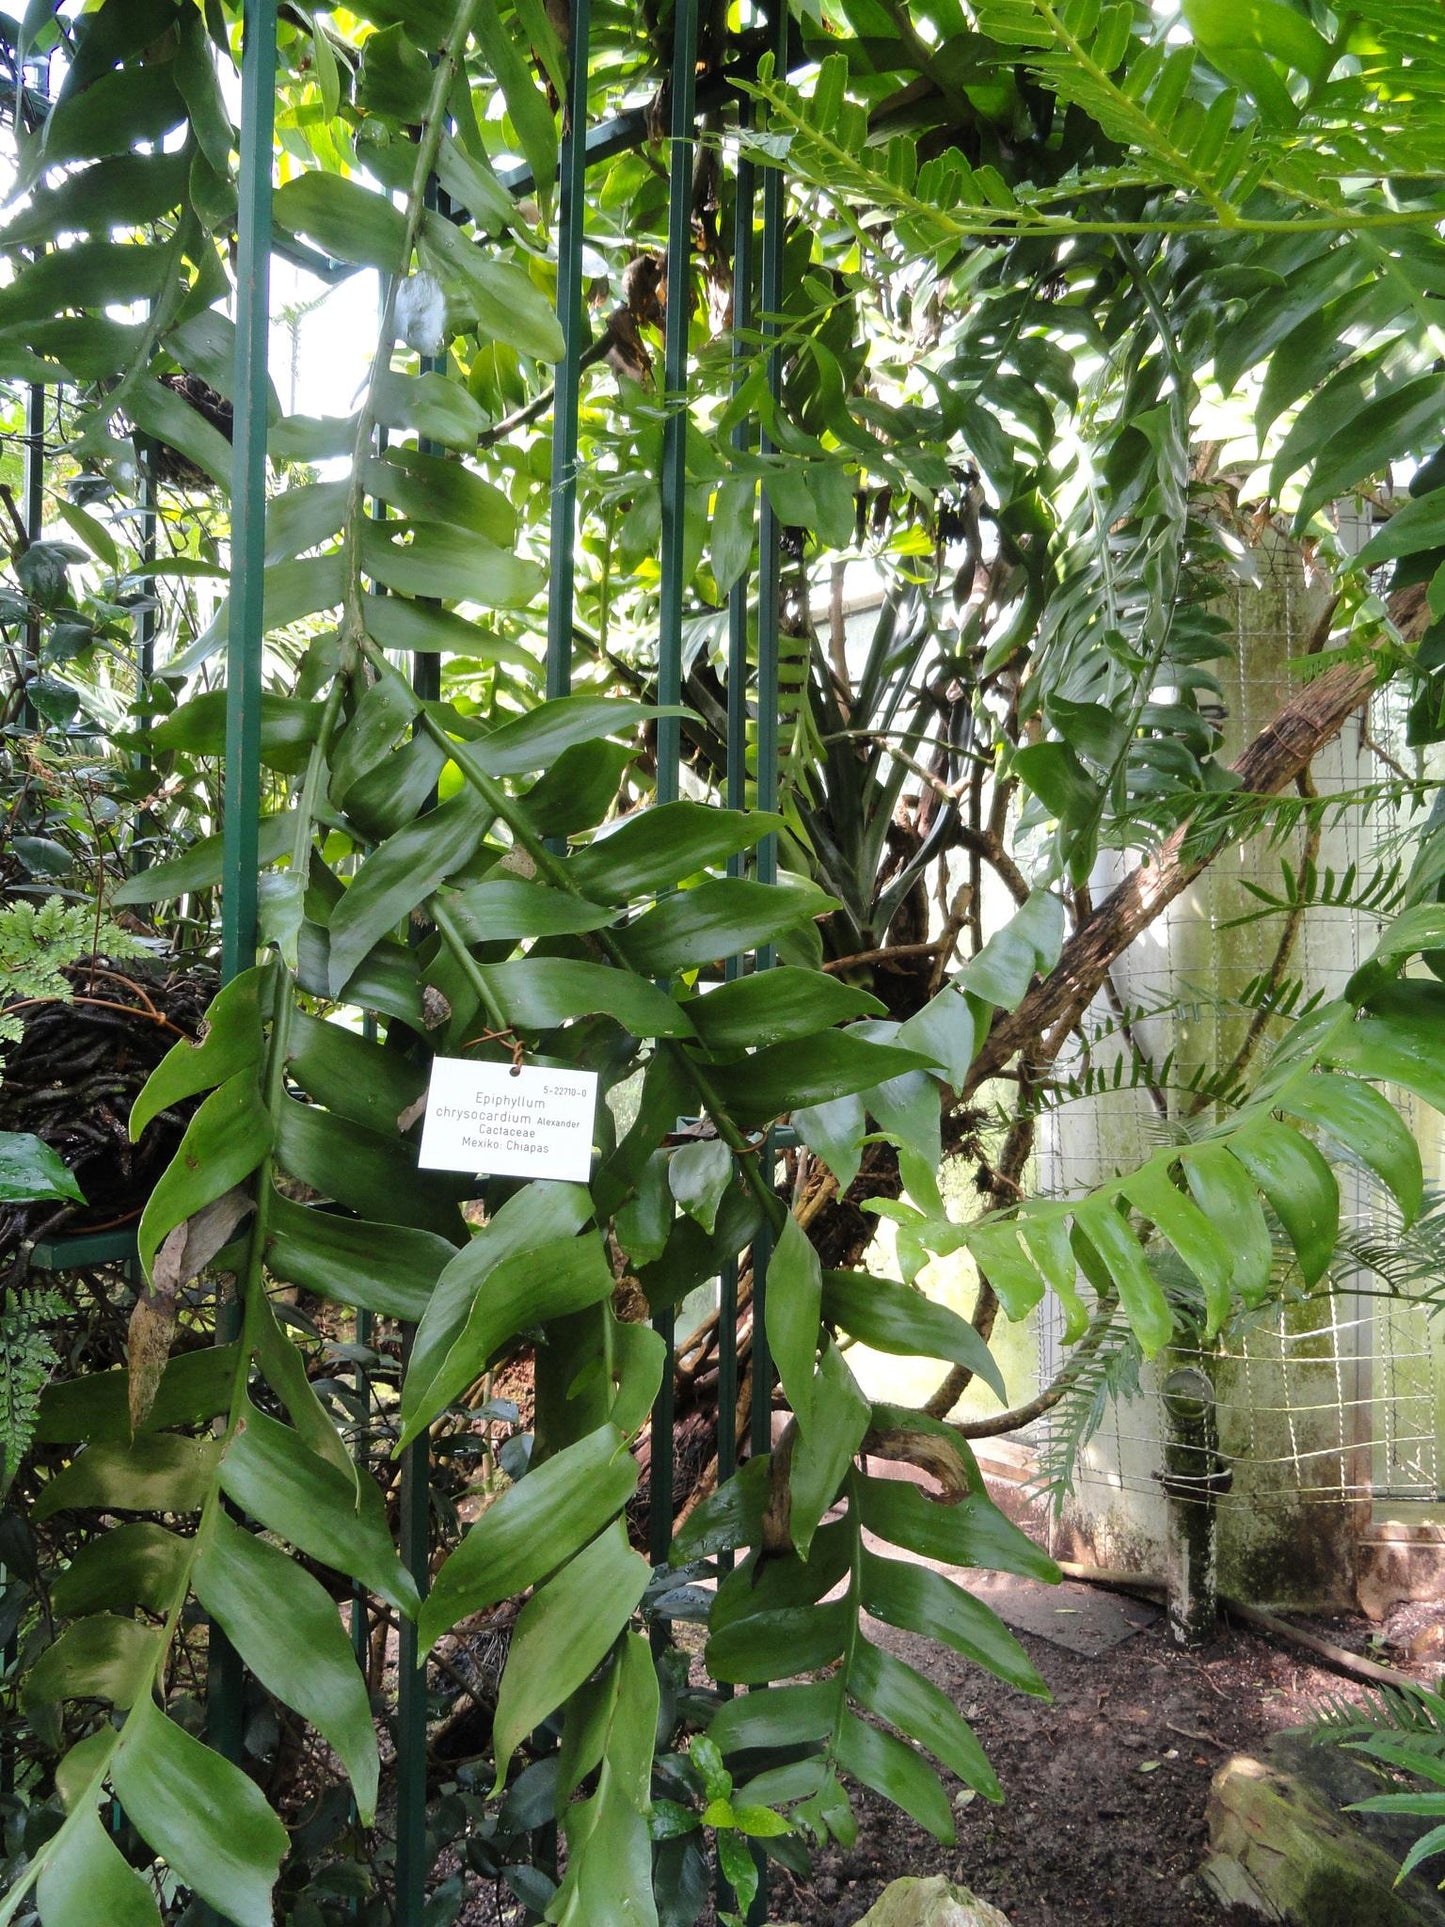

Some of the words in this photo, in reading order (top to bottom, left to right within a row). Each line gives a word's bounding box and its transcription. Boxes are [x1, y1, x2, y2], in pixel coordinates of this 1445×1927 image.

[475, 1091, 545, 1109] Epiphyllum
[435, 1106, 532, 1124] chrysocardium
[536, 1117, 580, 1128] Alexander
[479, 1124, 536, 1138] Cactaceae
[461, 1137, 503, 1150] Mexiko:
[506, 1140, 550, 1154] Chiapas
